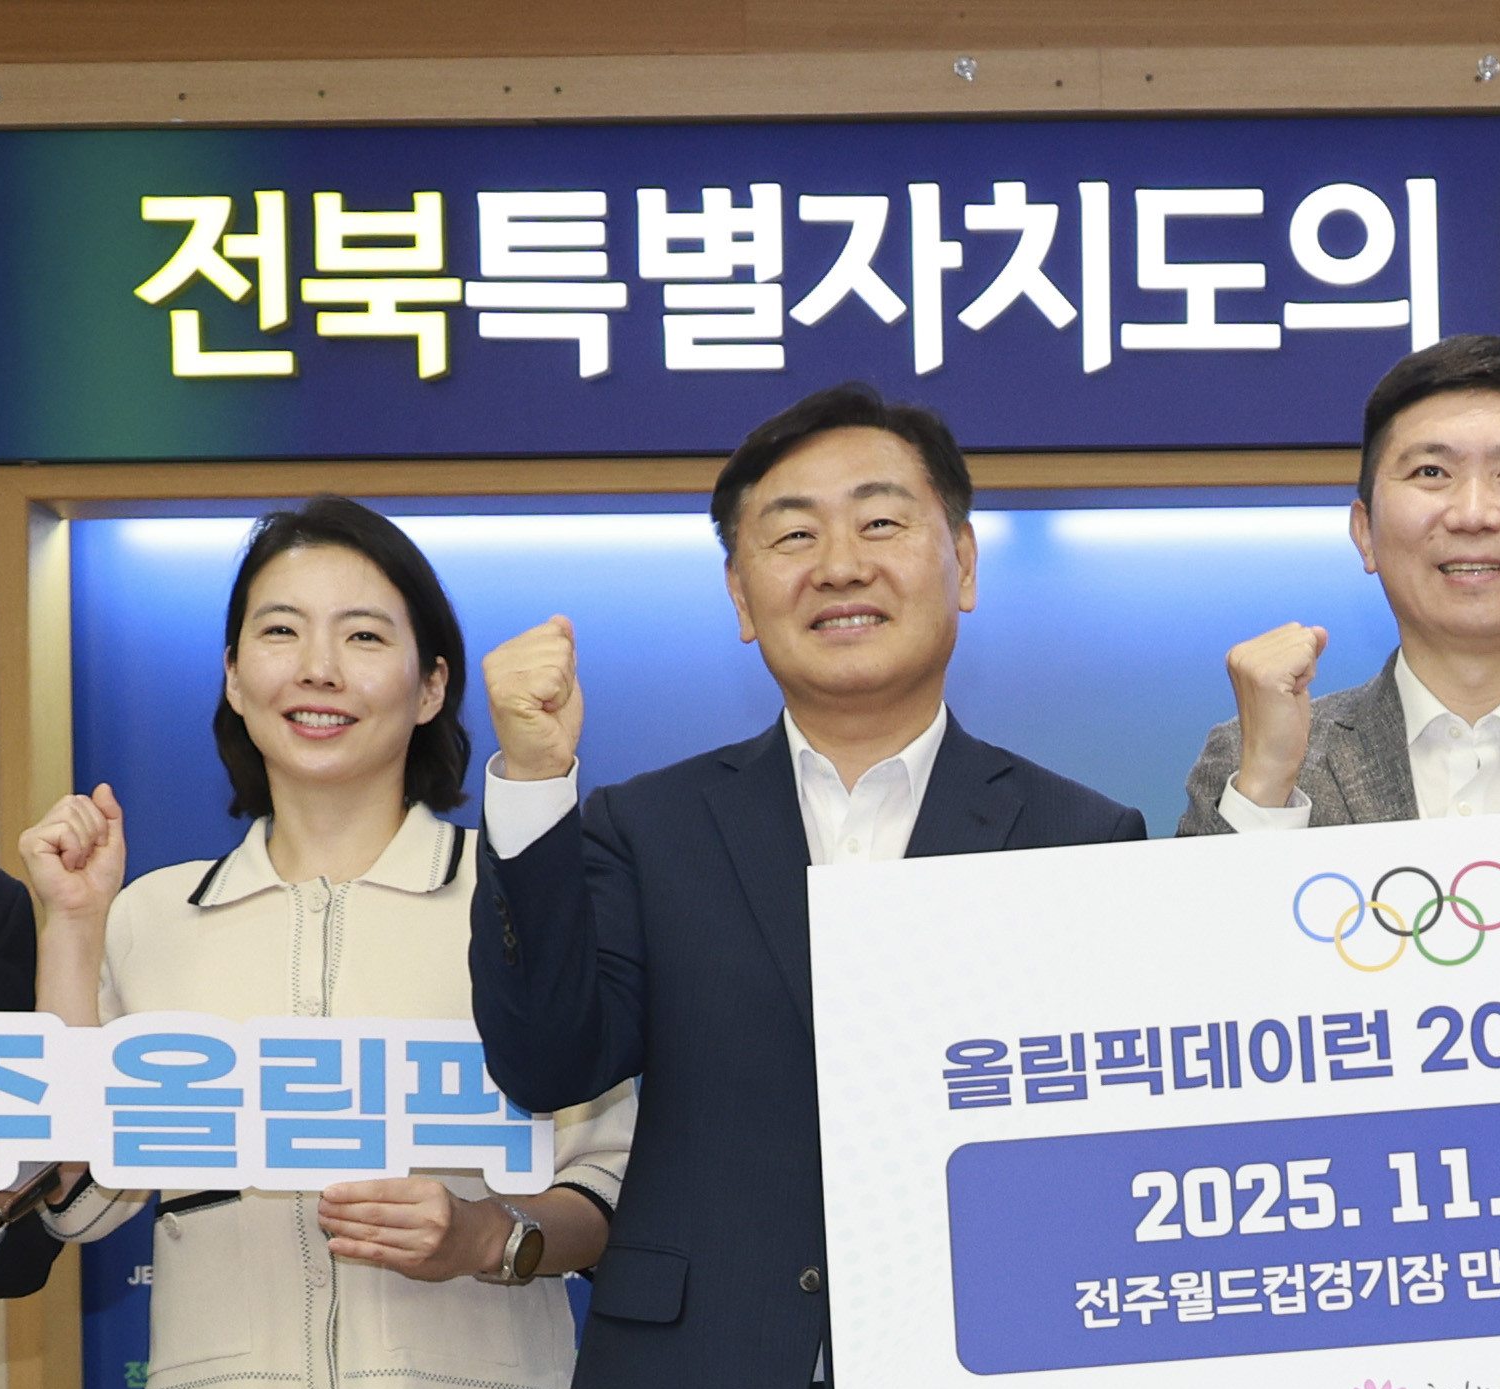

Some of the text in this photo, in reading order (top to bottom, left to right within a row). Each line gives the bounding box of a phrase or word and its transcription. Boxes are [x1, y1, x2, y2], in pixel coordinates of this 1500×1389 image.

[133, 178, 1439, 379] 전북특별자치도의
[103, 1031, 534, 1174] 올림픽
[942, 1009, 1395, 1111] 올림픽데이런
[1131, 1158, 1361, 1243] 2025.
[1075, 1253, 1449, 1329] 전주월드컵경기장
